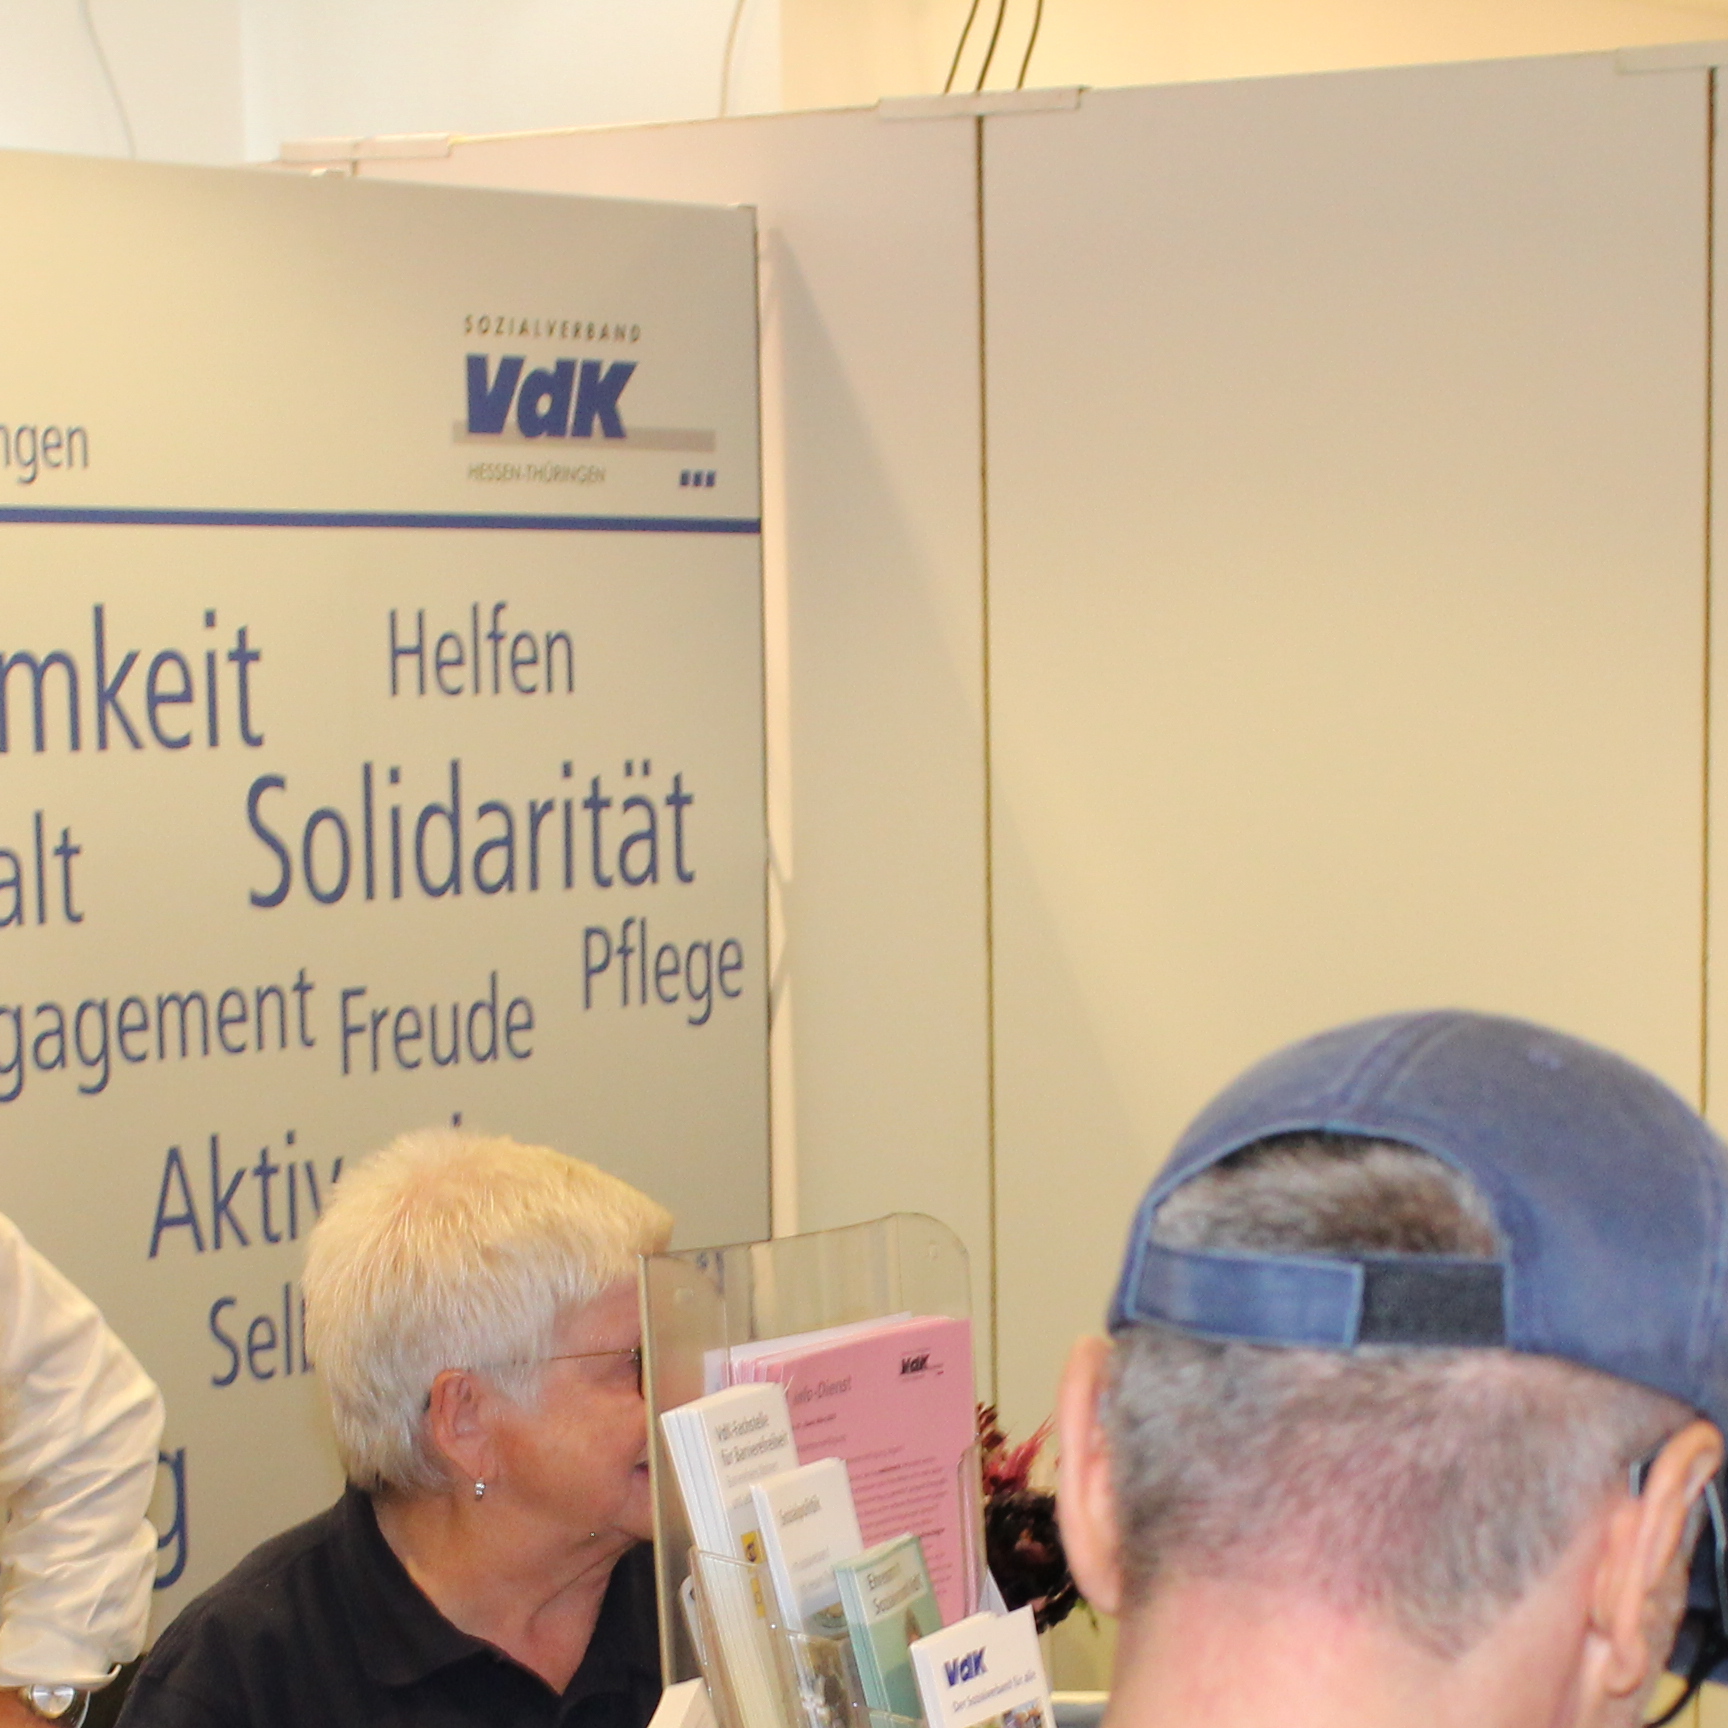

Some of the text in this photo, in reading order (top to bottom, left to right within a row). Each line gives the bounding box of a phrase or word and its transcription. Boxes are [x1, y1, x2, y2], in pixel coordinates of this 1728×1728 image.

[464, 314, 642, 344] SOZIALVERBAND
[466, 353, 638, 439] VdK
[467, 461, 607, 487] HESSEN-THÜRINGEN
[388, 601, 575, 698] Helfen
[246, 758, 696, 909] Solidarität
[583, 916, 745, 1027] Pflege
[341, 969, 535, 1077] Freude
[944, 1646, 987, 1687] VdK
